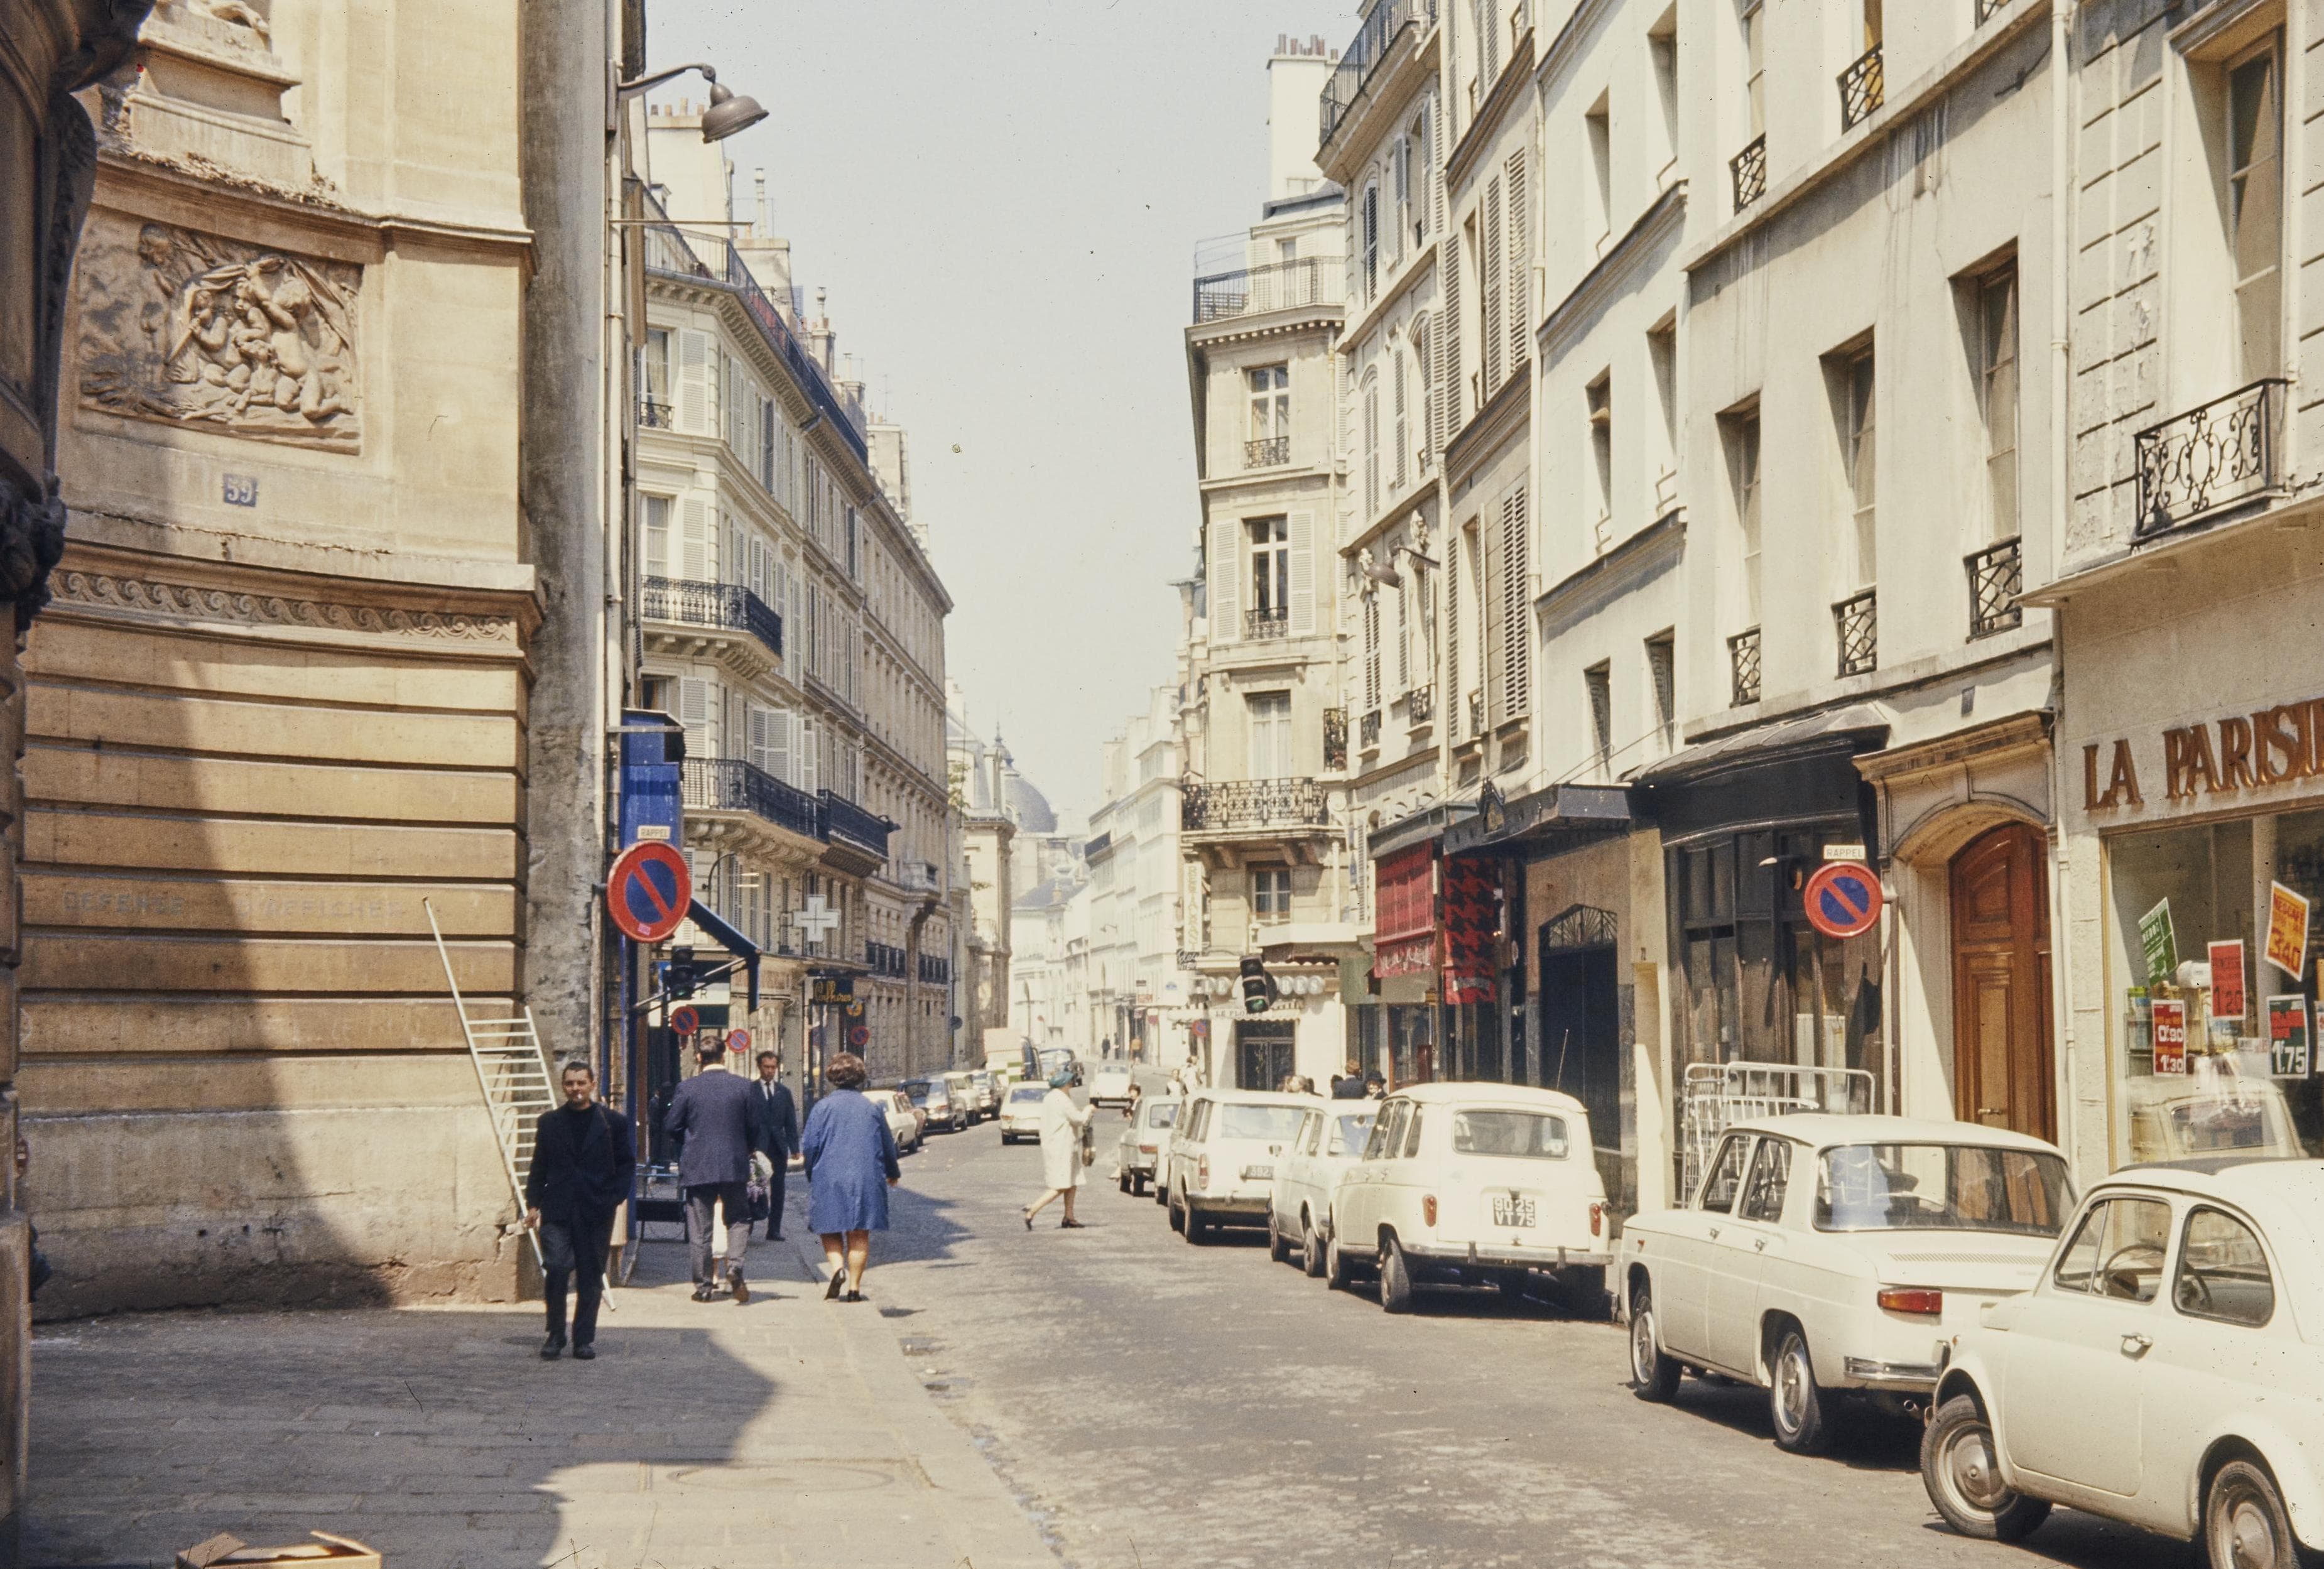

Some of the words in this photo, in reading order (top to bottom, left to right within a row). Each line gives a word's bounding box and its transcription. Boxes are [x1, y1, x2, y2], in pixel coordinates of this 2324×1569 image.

[227, 477, 252, 503] 59
[2082, 738, 2144, 811] LA
[641, 828, 667, 837] RAPPEL
[1826, 848, 1863, 858] RAPPEL
[63, 890, 185, 915] DEFENSE
[1495, 1211, 1514, 1226] VT
[1517, 1212, 1535, 1227] 75
